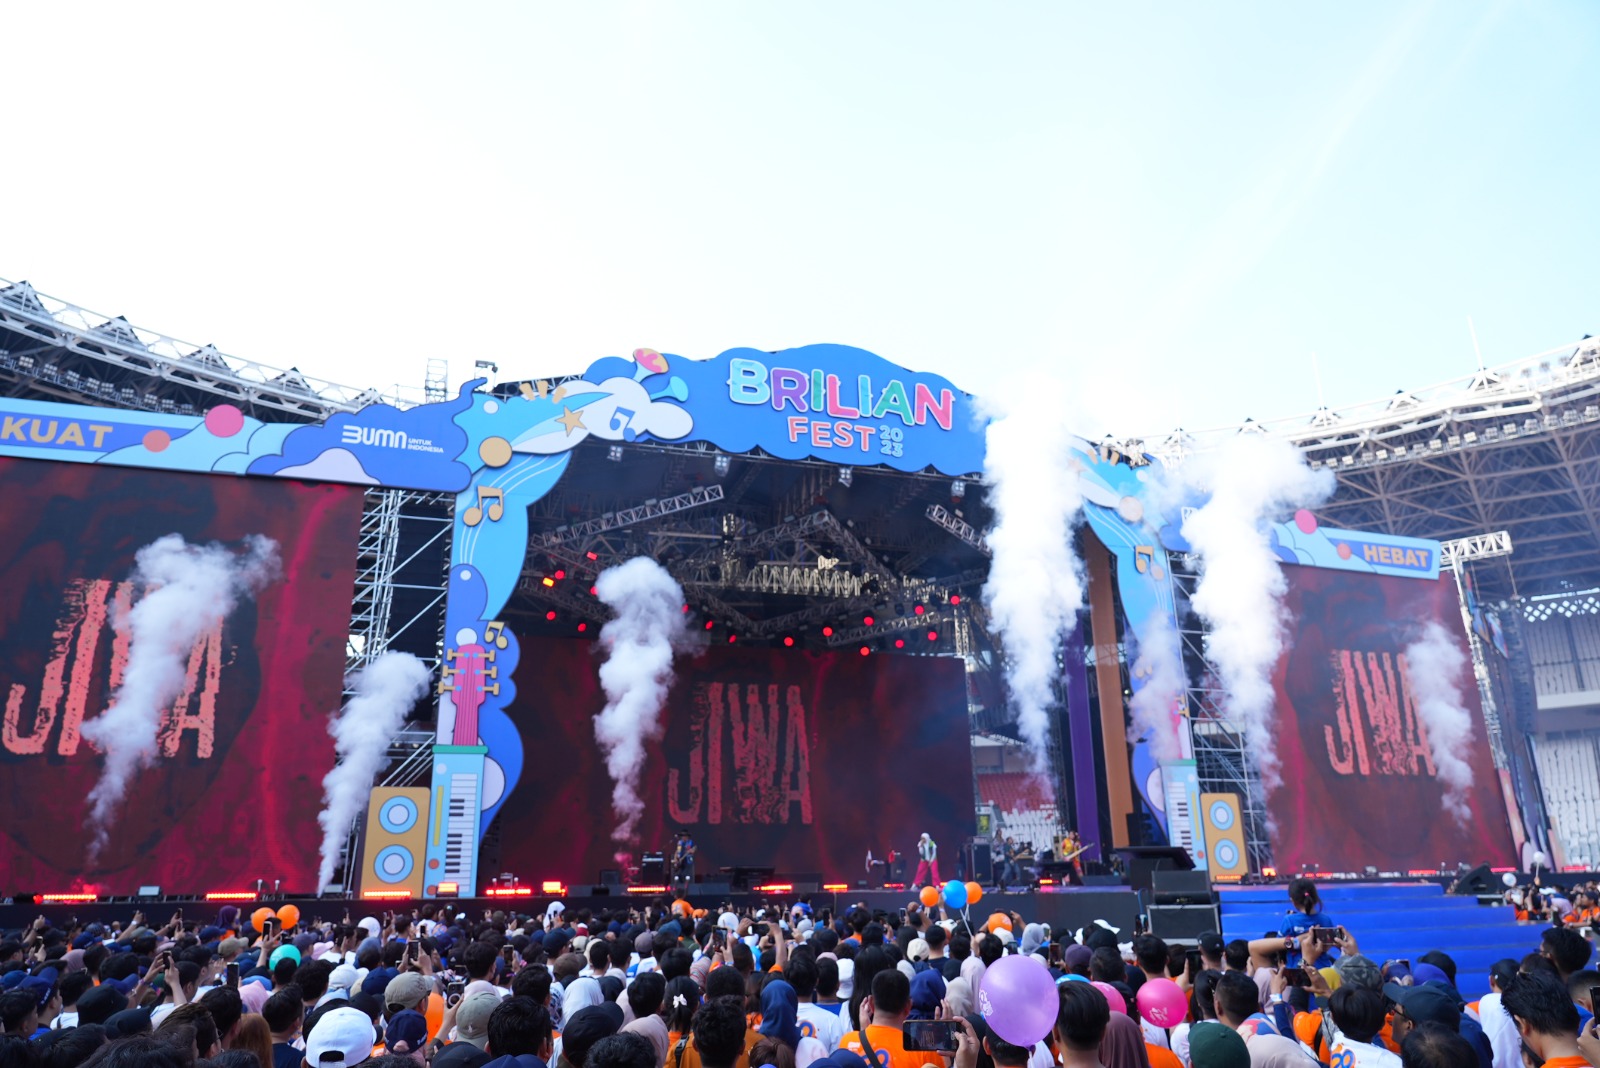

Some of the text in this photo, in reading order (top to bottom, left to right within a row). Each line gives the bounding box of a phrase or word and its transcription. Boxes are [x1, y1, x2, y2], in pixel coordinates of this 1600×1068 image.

[728, 358, 954, 430] BRILIAN
[1, 416, 113, 448] KUAT
[407, 444, 444, 453] INDONESIA
[408, 438, 432, 446] UNTUK
[788, 416, 876, 451] FEST
[1363, 544, 1428, 567] HEBAT
[2, 578, 224, 758] JIA
[668, 682, 813, 824] JIWA
